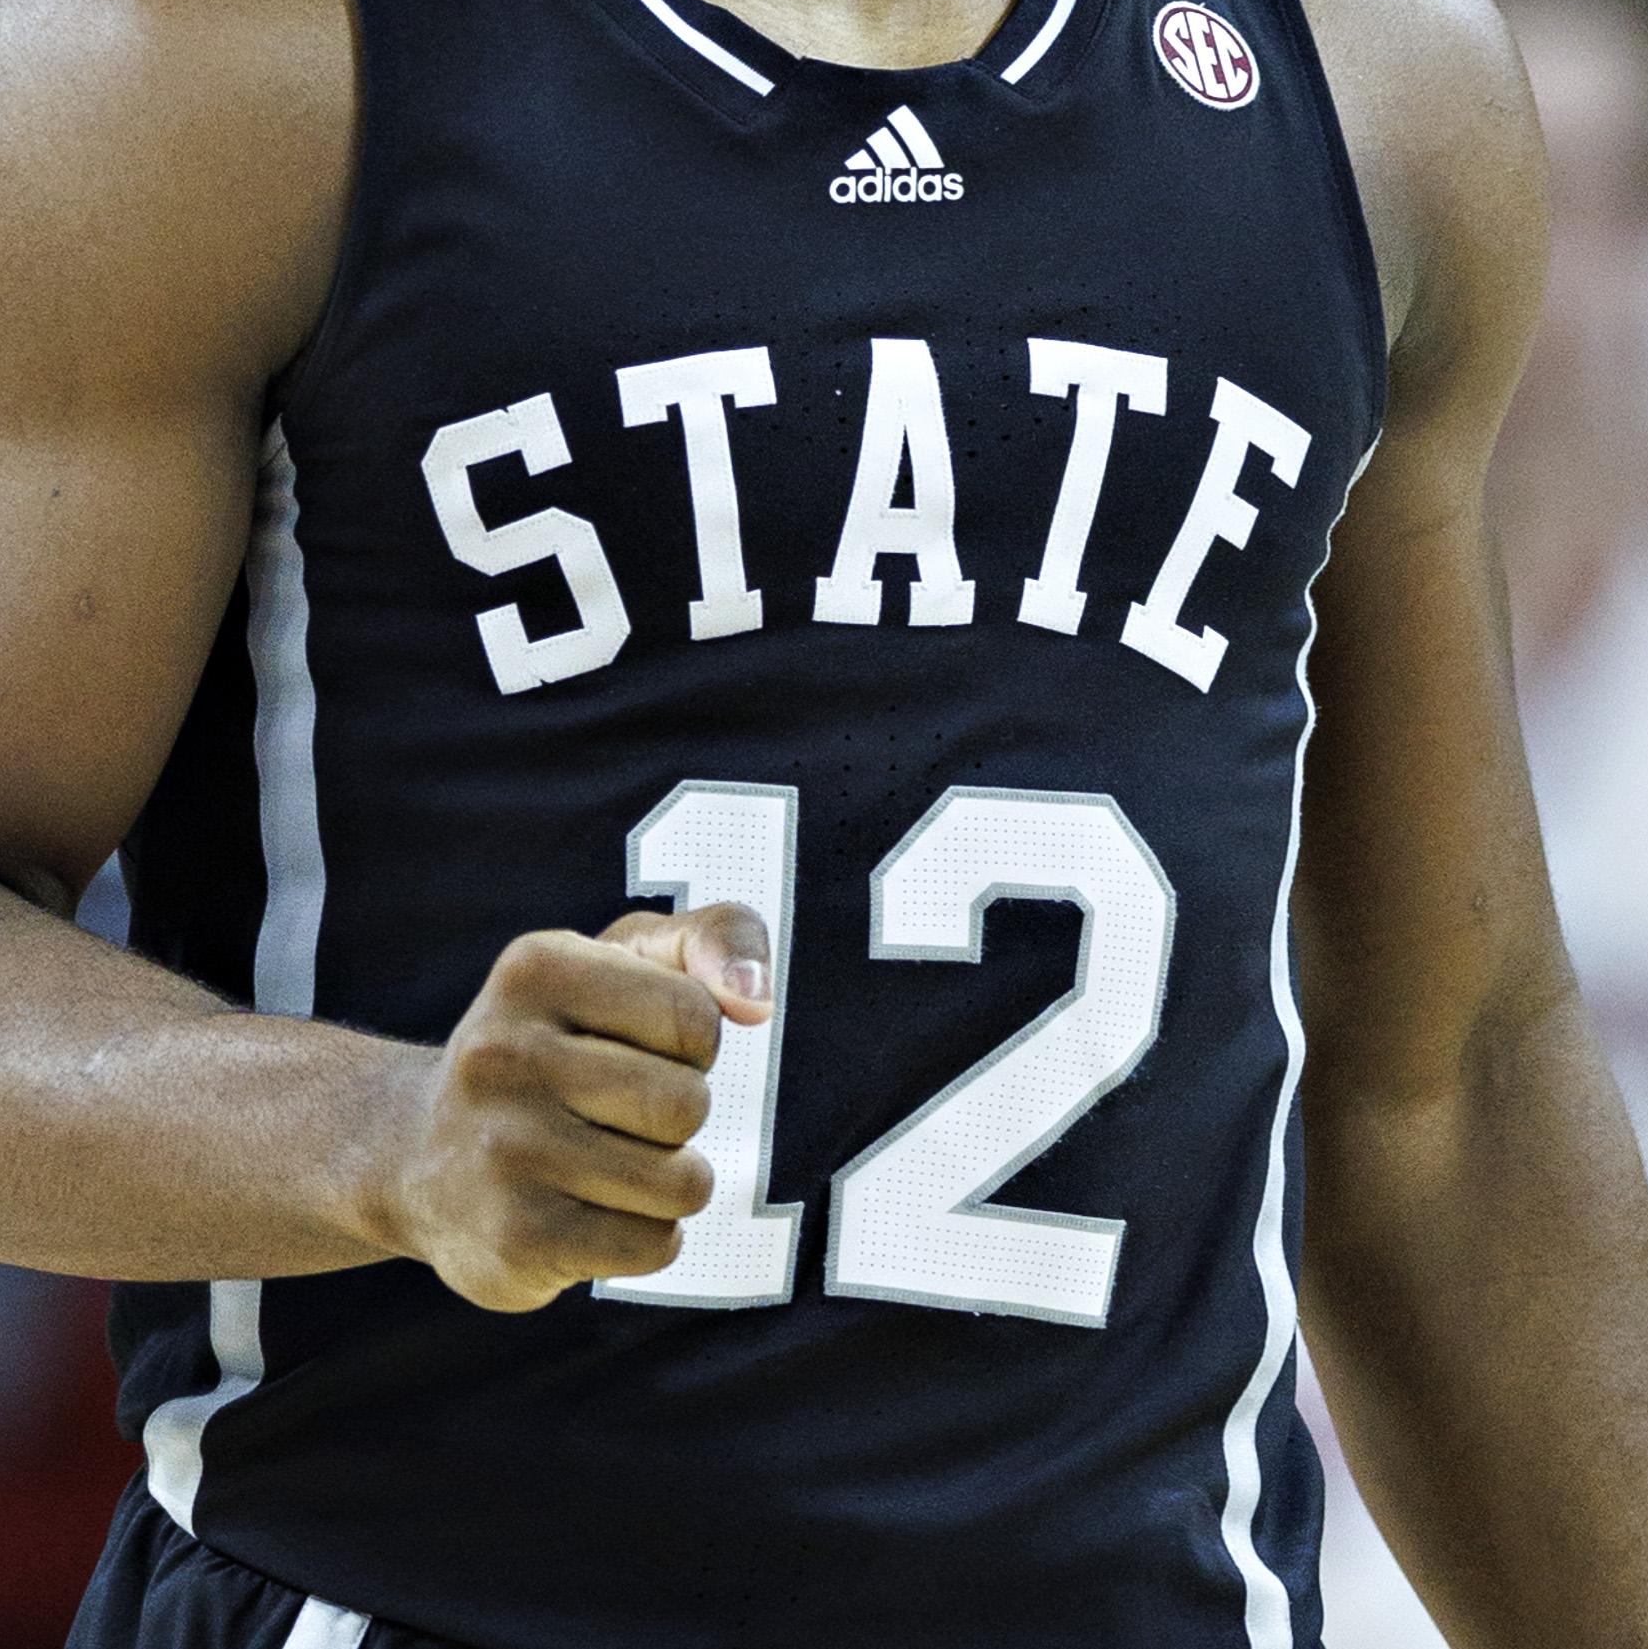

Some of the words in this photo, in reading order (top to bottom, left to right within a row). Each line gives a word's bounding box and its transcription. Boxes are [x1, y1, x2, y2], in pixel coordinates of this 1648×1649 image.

[1163, 11, 1250, 99] SEC
[828, 167, 965, 204] adidas
[420, 337, 1312, 696] STATE
[591, 779, 1178, 1330] 12
